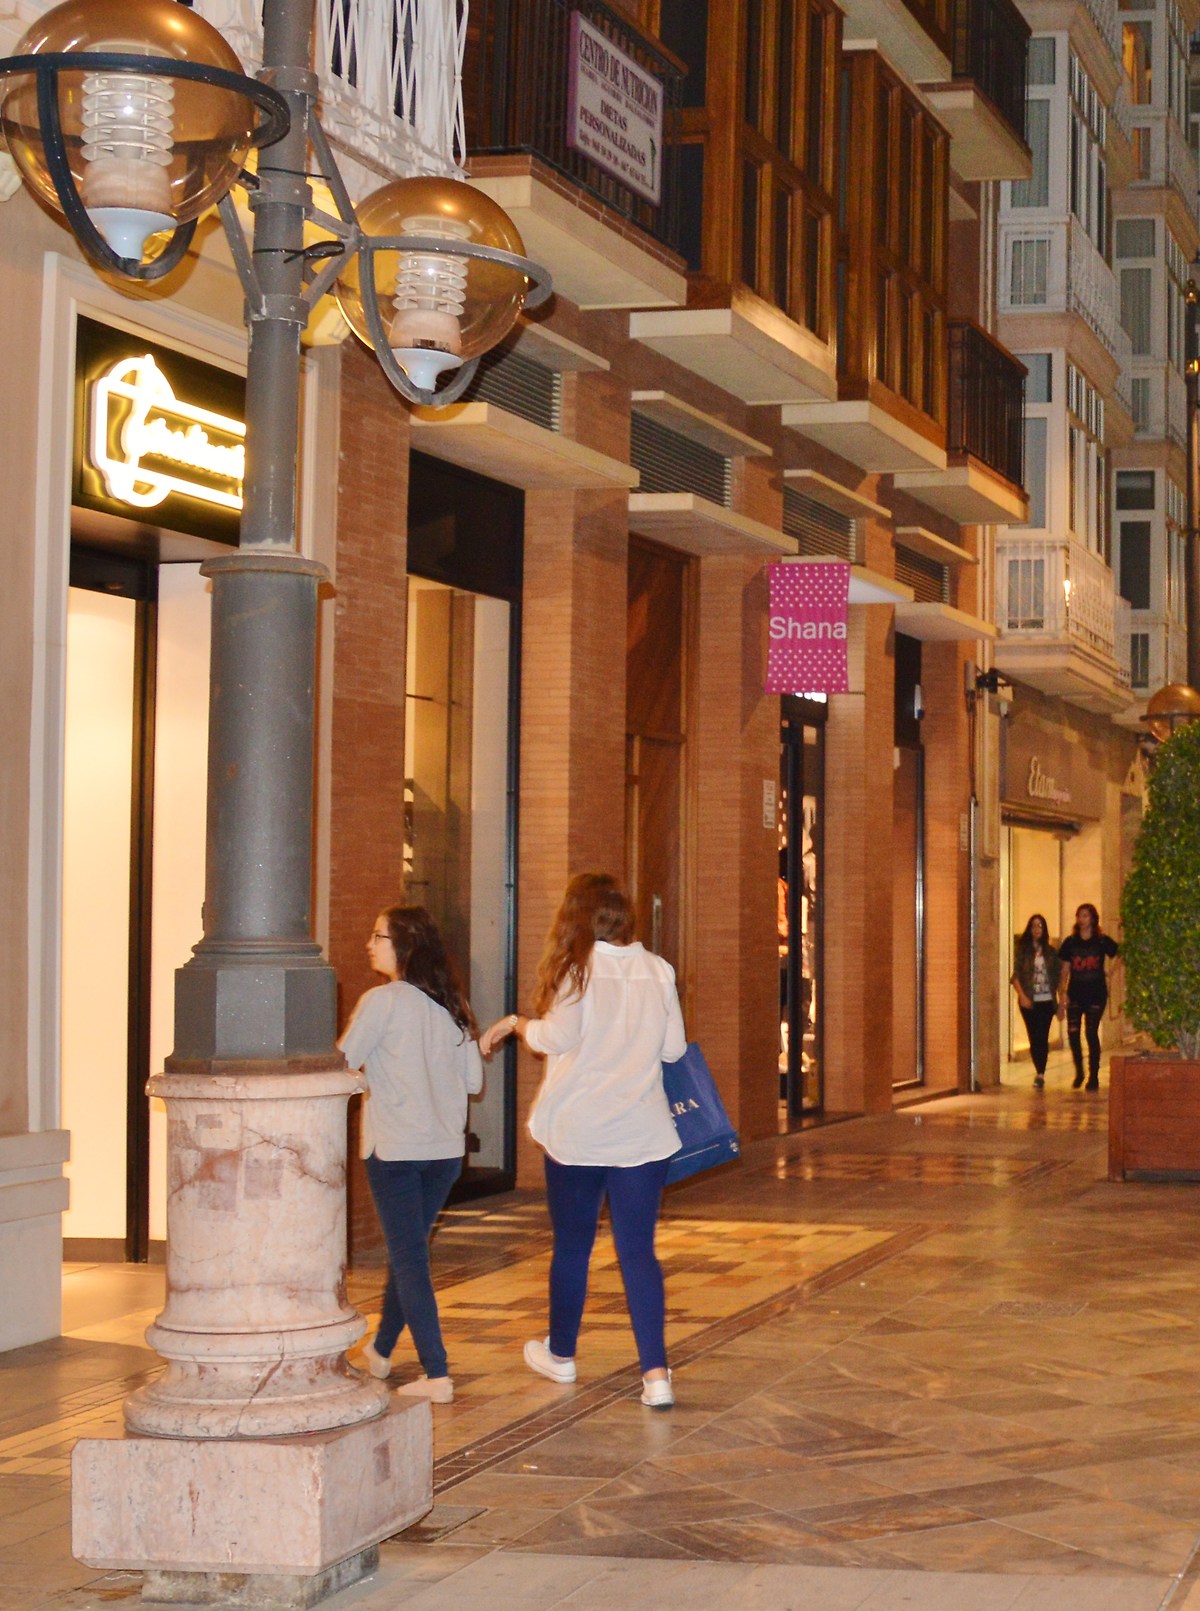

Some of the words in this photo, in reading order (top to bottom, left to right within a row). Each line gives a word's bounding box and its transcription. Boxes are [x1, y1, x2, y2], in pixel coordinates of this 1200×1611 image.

[580, 30, 609, 77] CENTRO
[610, 56, 621, 88] DE
[601, 100, 627, 131] DIETAS
[580, 106, 646, 167] PERSONALIZADAS
[769, 616, 847, 640] Shana
[671, 1098, 700, 1117] RA
